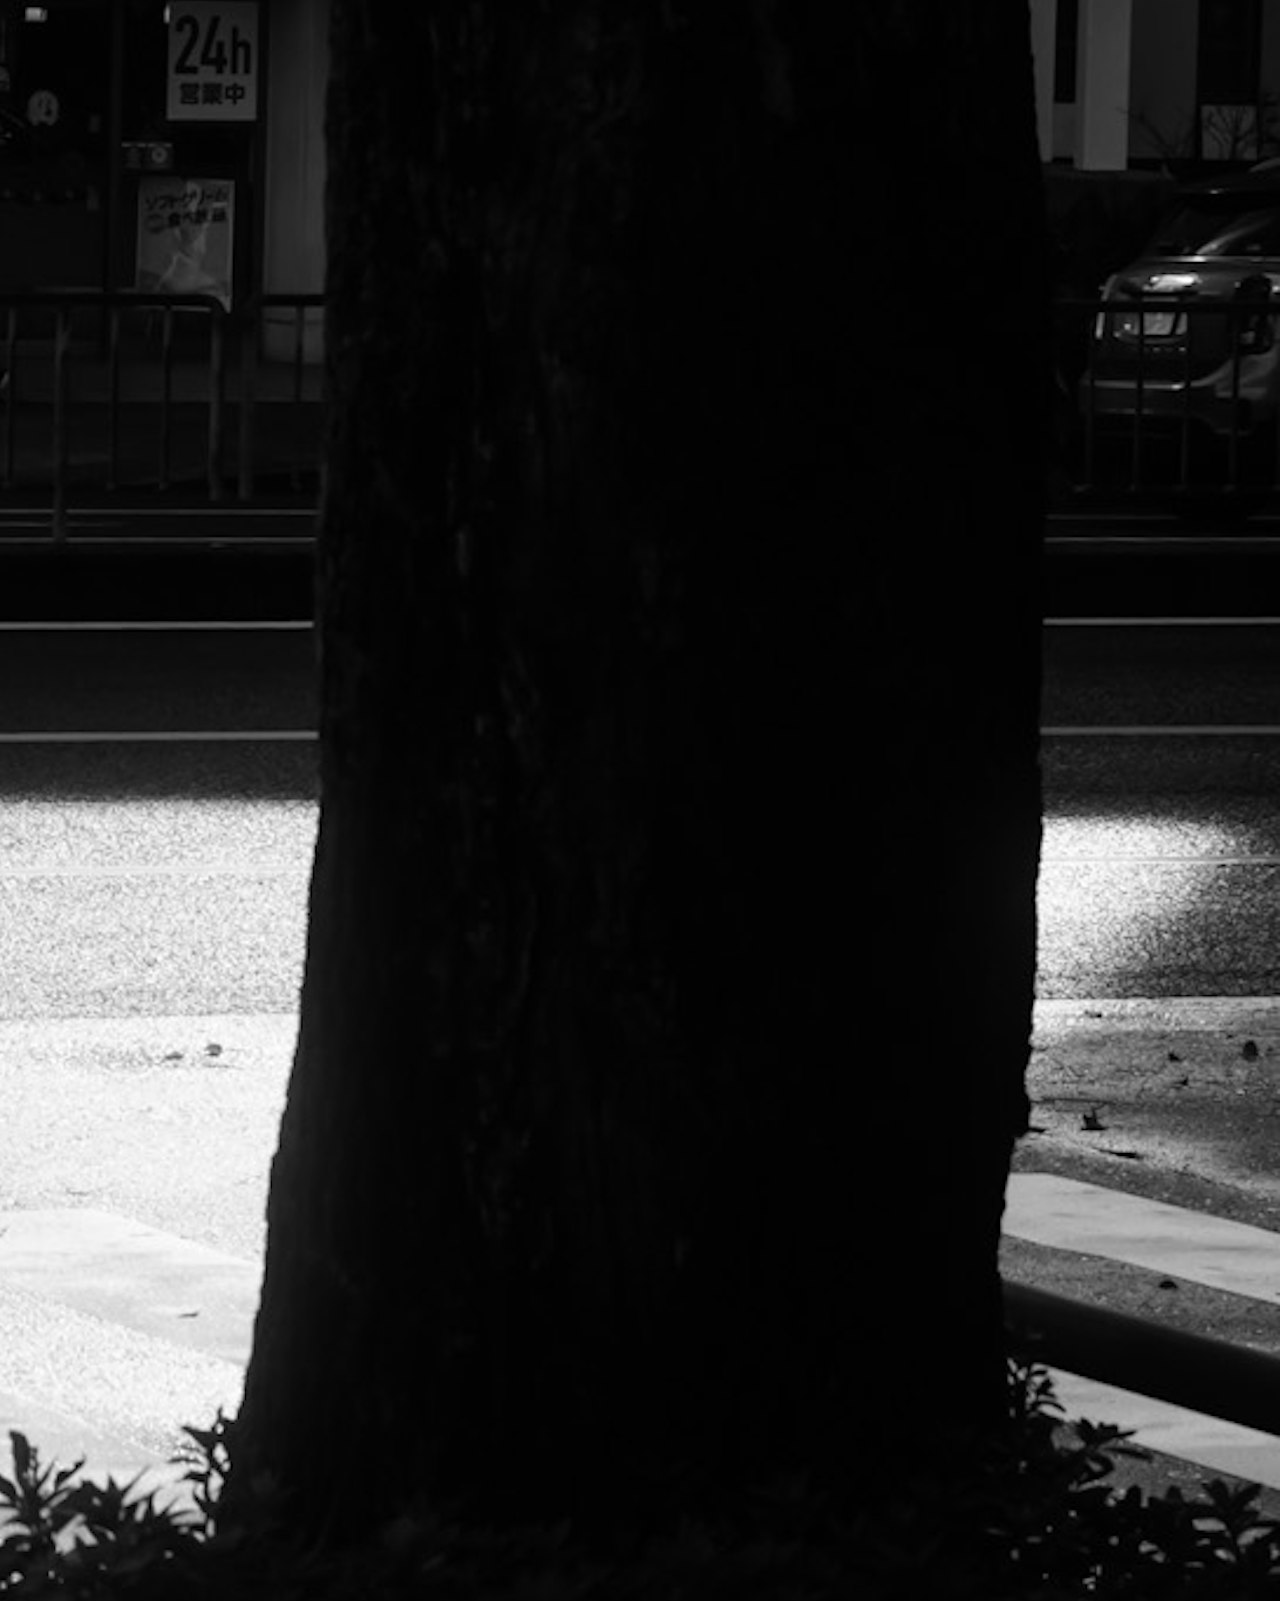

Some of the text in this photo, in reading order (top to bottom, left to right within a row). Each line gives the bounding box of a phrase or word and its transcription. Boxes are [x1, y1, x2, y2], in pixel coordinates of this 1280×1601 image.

[174, 14, 252, 75] 24h
[178, 82, 246, 106] 営業中
